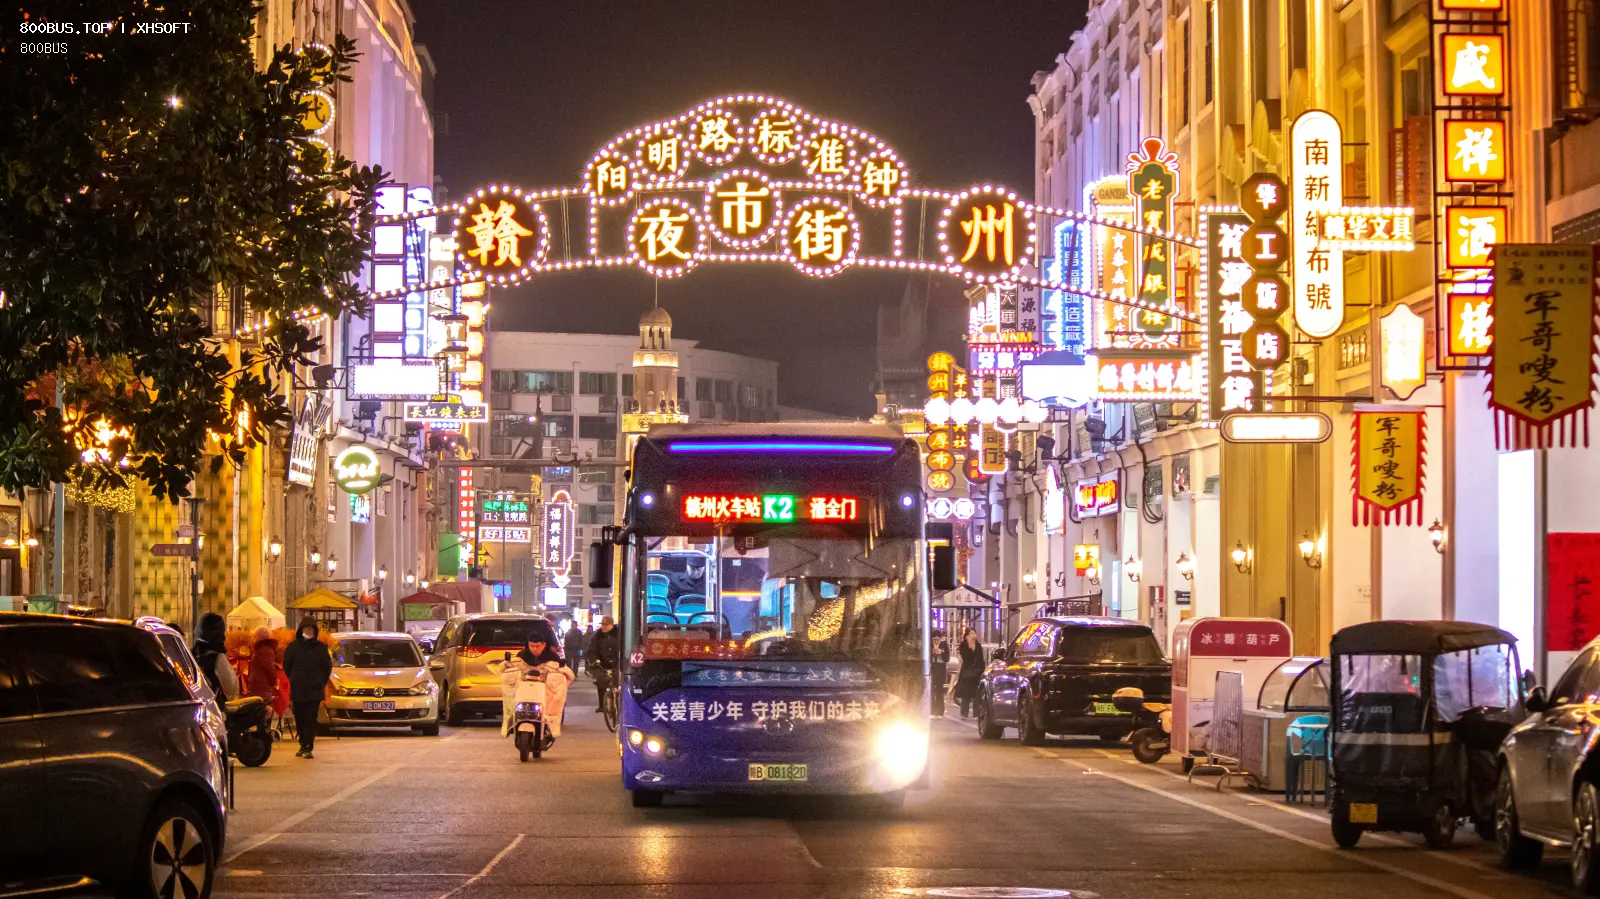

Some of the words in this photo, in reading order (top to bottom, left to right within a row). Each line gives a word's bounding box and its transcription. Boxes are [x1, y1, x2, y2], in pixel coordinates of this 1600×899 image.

[597, 118, 898, 198] 阳明路标准钟
[640, 181, 849, 262] 夜市街
[960, 203, 1016, 266] 州
[1516, 291, 1566, 415] 军哥嫂粉
[1372, 416, 1405, 501] 军哥嫂粉
[685, 496, 762, 520] 赣州火车站
[763, 496, 793, 520] K2
[810, 496, 857, 520] 涌金门
[630, 652, 643, 664] K2
[1200, 632, 1280, 646] 冰糖葫芦
[652, 701, 743, 722] 关爱青少年
[752, 701, 882, 722] 守护我们的未来
